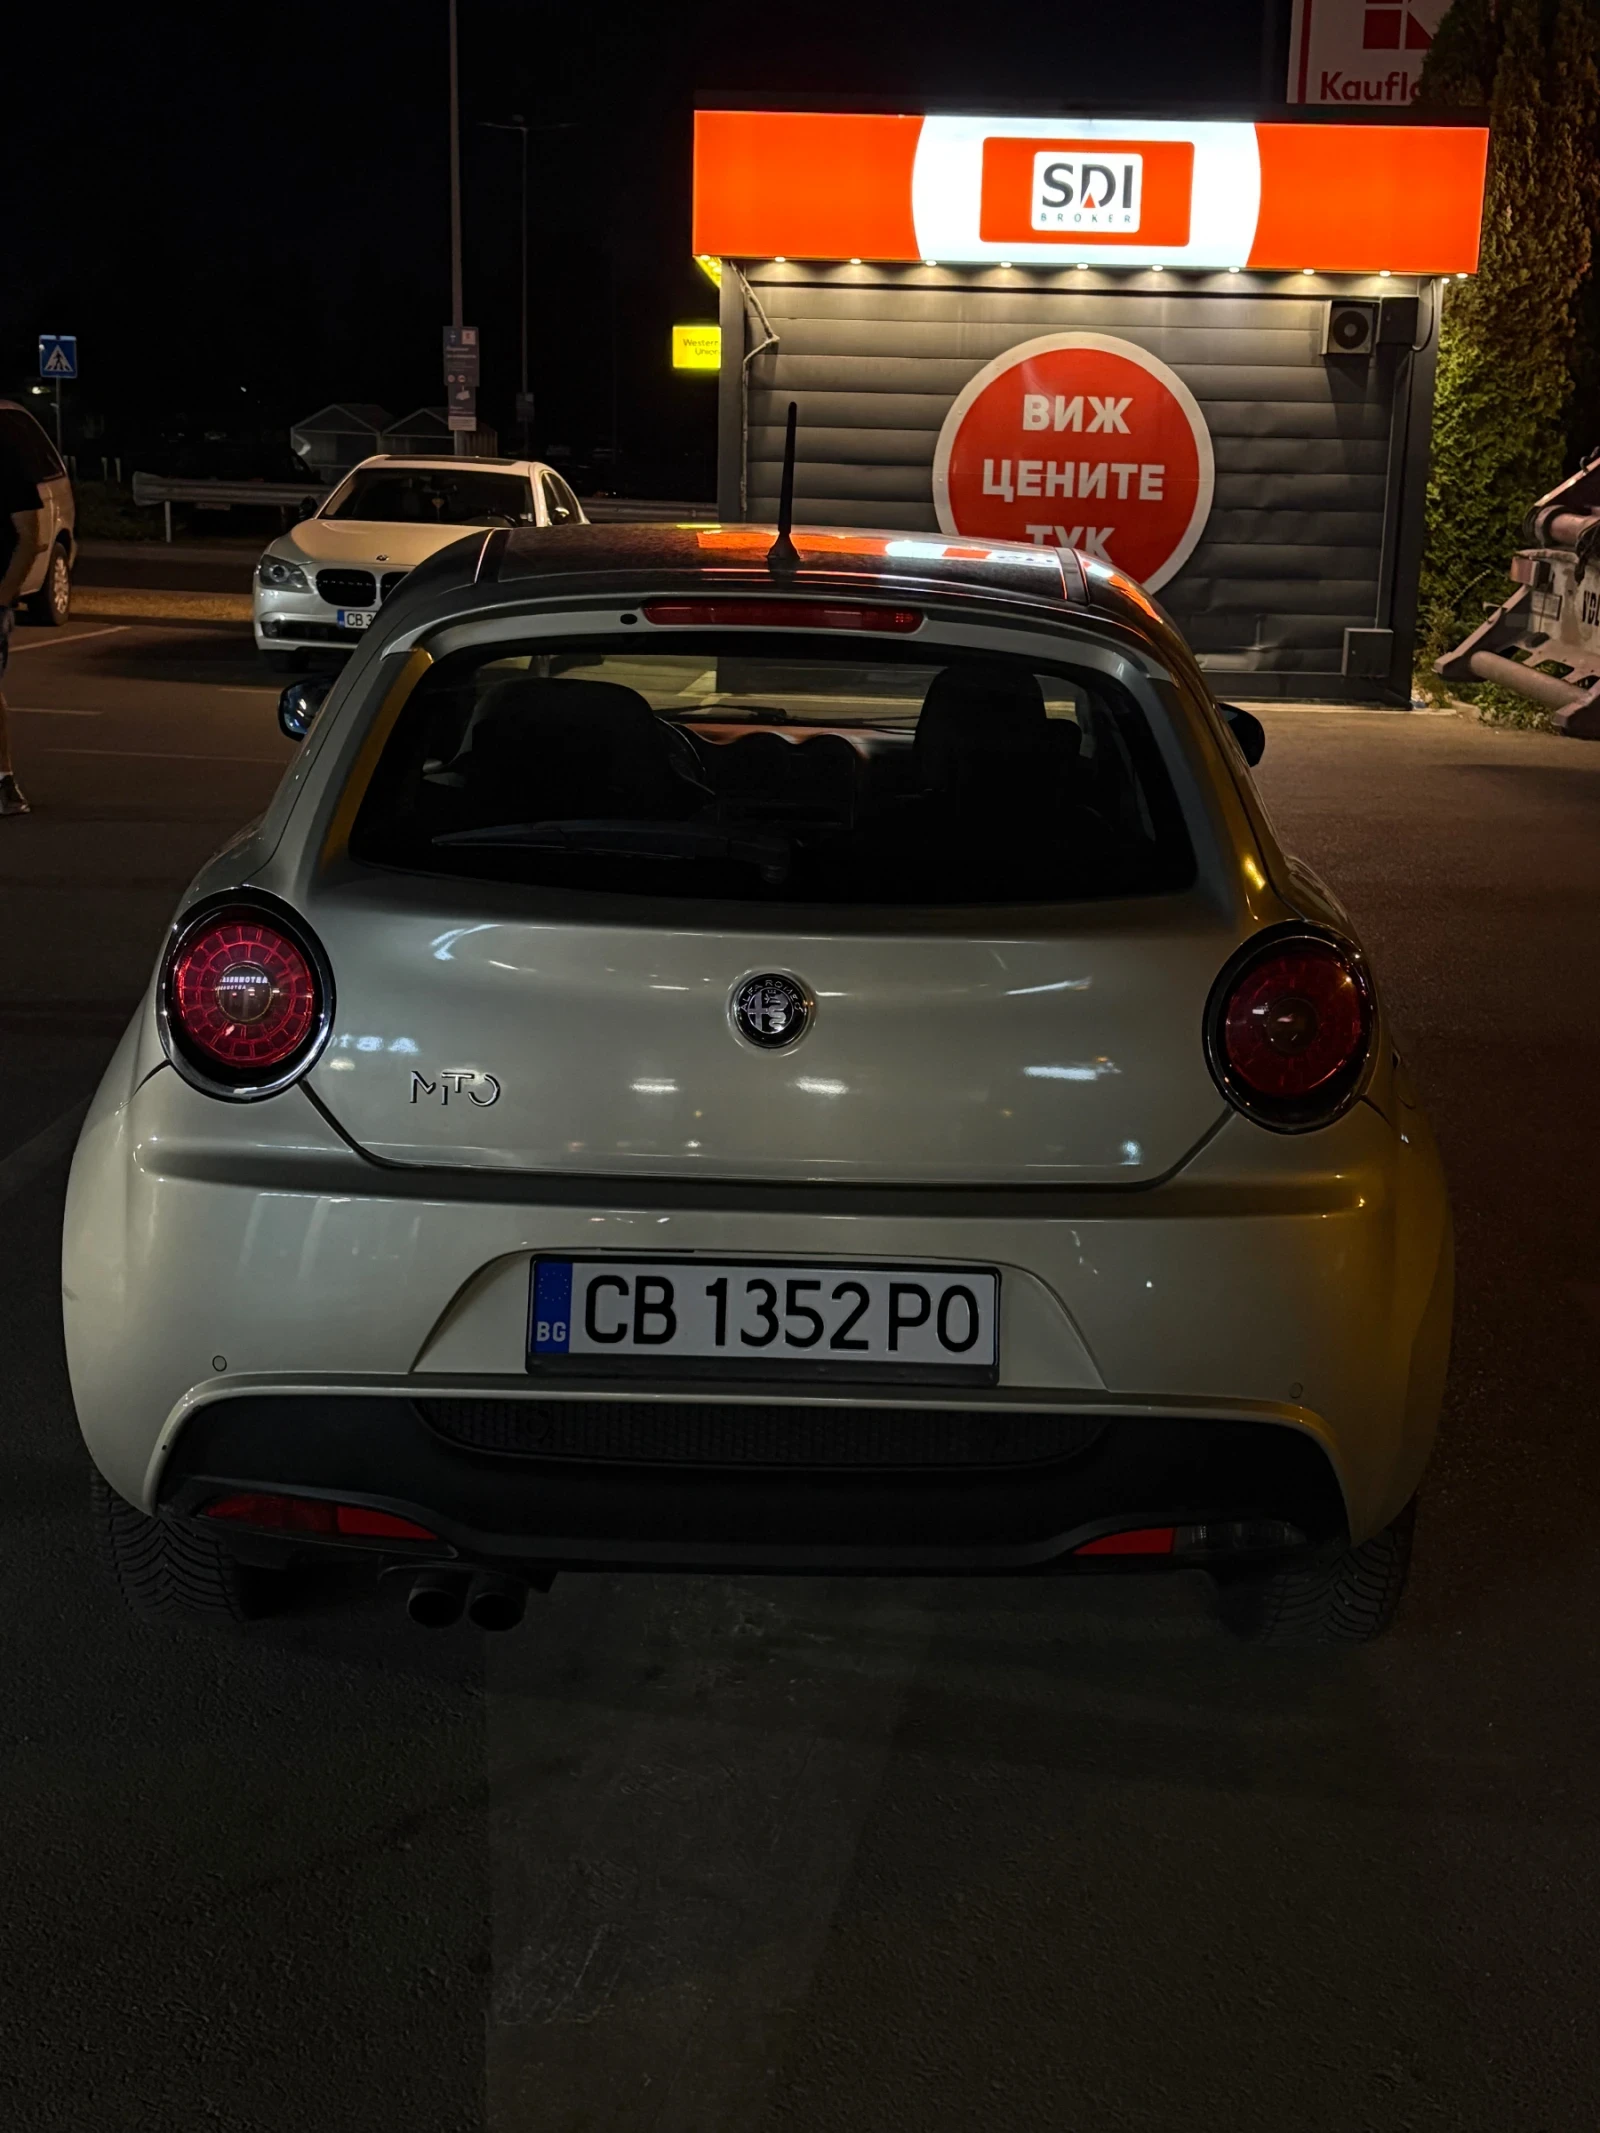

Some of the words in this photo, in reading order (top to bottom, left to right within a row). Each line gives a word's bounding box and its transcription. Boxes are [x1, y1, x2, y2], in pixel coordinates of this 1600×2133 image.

[1042, 162, 1134, 209] SDI
[1041, 213, 1132, 224] BROKER
[1022, 394, 1133, 434] ВИЖ
[982, 459, 1166, 504] ЦЕНИТЕ
[346, 612, 364, 627] CB
[739, 984, 764, 1013] ALFA
[764, 979, 804, 1013] ROMEO
[584, 1274, 678, 1346] CB
[704, 1277, 871, 1351] 1352
[535, 1320, 567, 1345] BG
